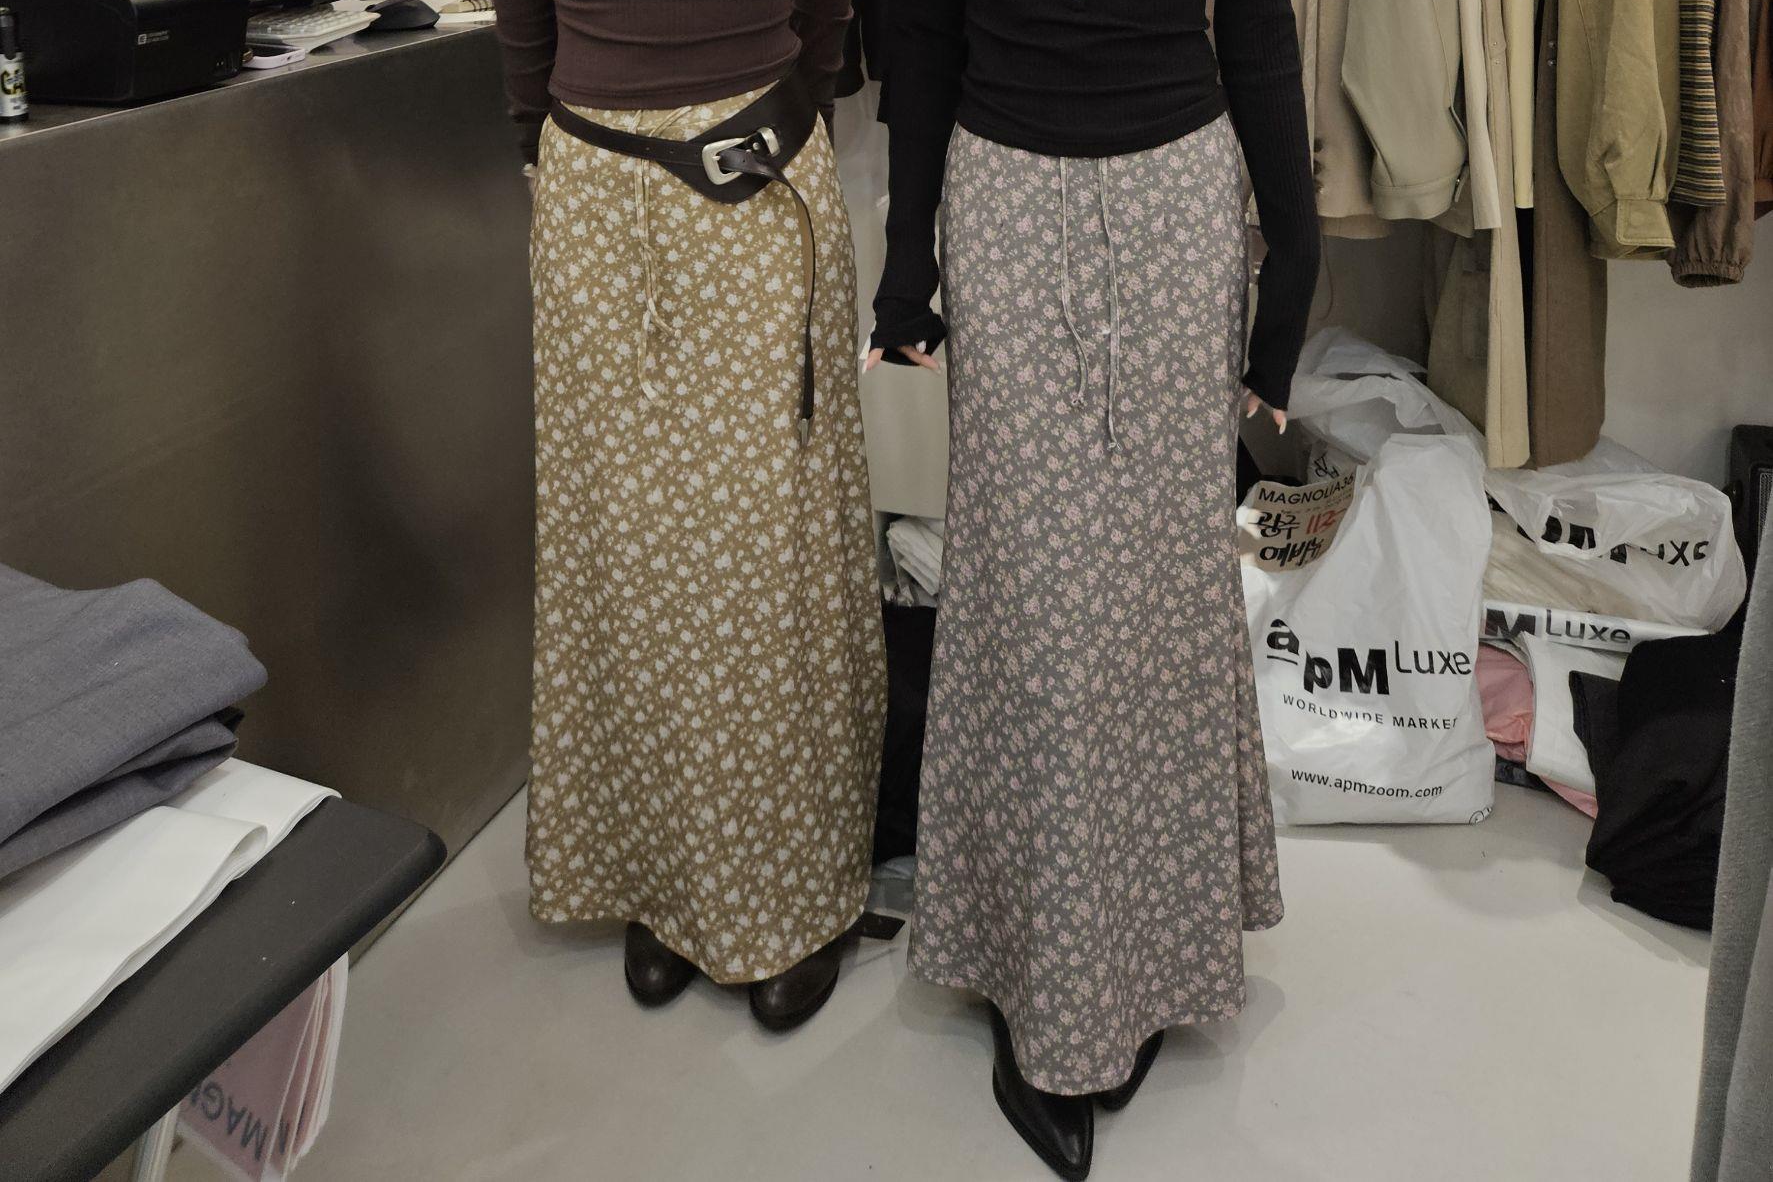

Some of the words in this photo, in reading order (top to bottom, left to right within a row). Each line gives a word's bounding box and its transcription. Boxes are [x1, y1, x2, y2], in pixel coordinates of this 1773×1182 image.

[1546, 609, 1631, 644] Luxe
[1394, 640, 1473, 676] Luxe
[1282, 693, 1384, 724] WORLDWIDE
[1290, 769, 1443, 798] www.apmzoom.com
